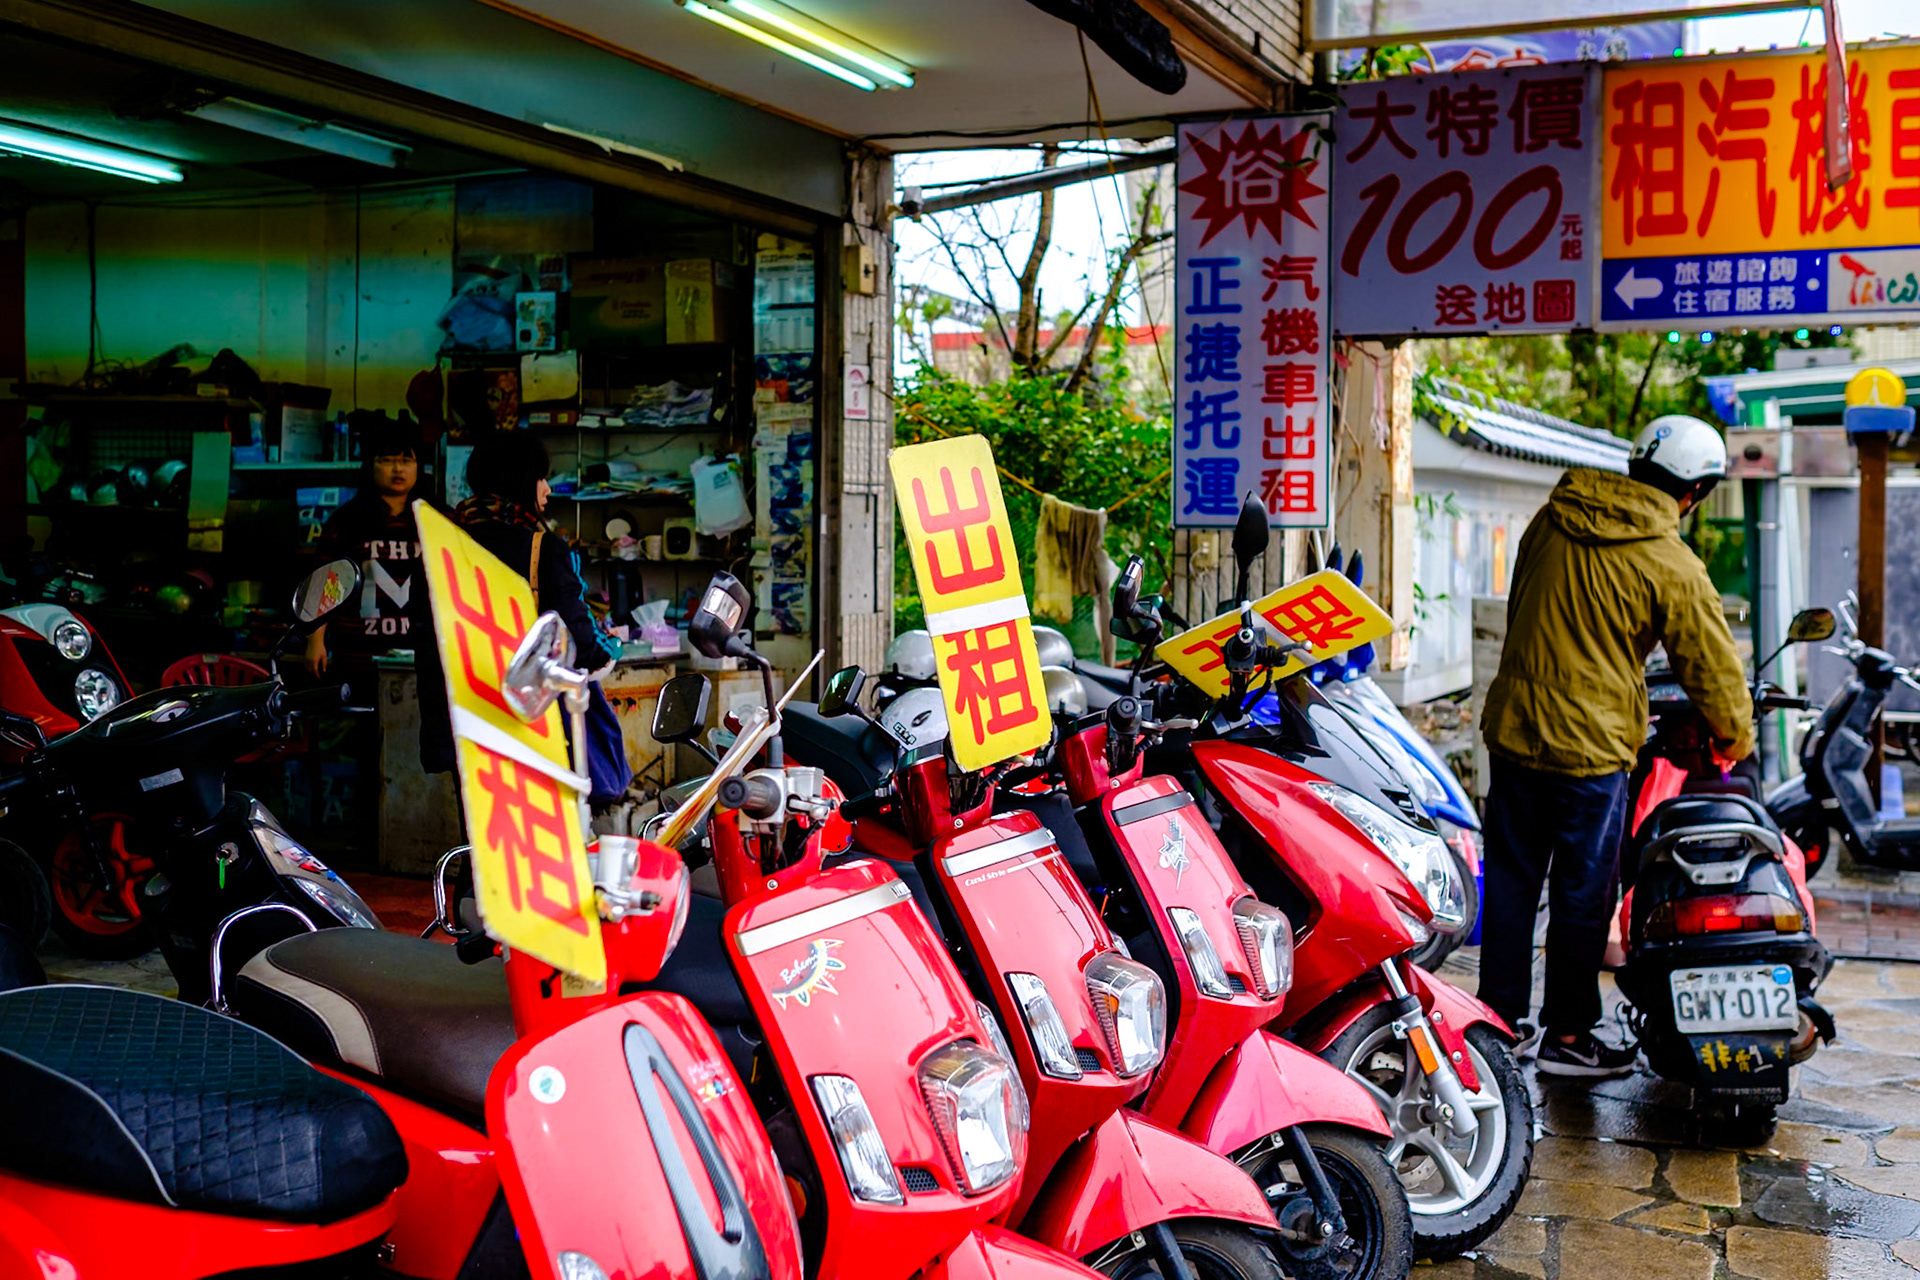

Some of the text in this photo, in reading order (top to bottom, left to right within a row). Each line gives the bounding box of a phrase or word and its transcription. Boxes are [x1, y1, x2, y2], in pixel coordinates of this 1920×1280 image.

[1346, 77, 1585, 163] 大特價
[1218, 149, 1285, 209] 俗
[1341, 165, 1563, 277] 100
[1560, 214, 1583, 260] 元起
[1435, 280, 1575, 326] 送地圖
[1673, 286, 1796, 313] 住宿服務
[1674, 257, 1798, 285] 旅遊諮詢
[1839, 253, 1920, 306] Taiw
[1183, 257, 1243, 516] 正捷托運
[1261, 254, 1320, 514] 汽機車出租
[911, 466, 1039, 745] 出租
[441, 547, 590, 938] 出租
